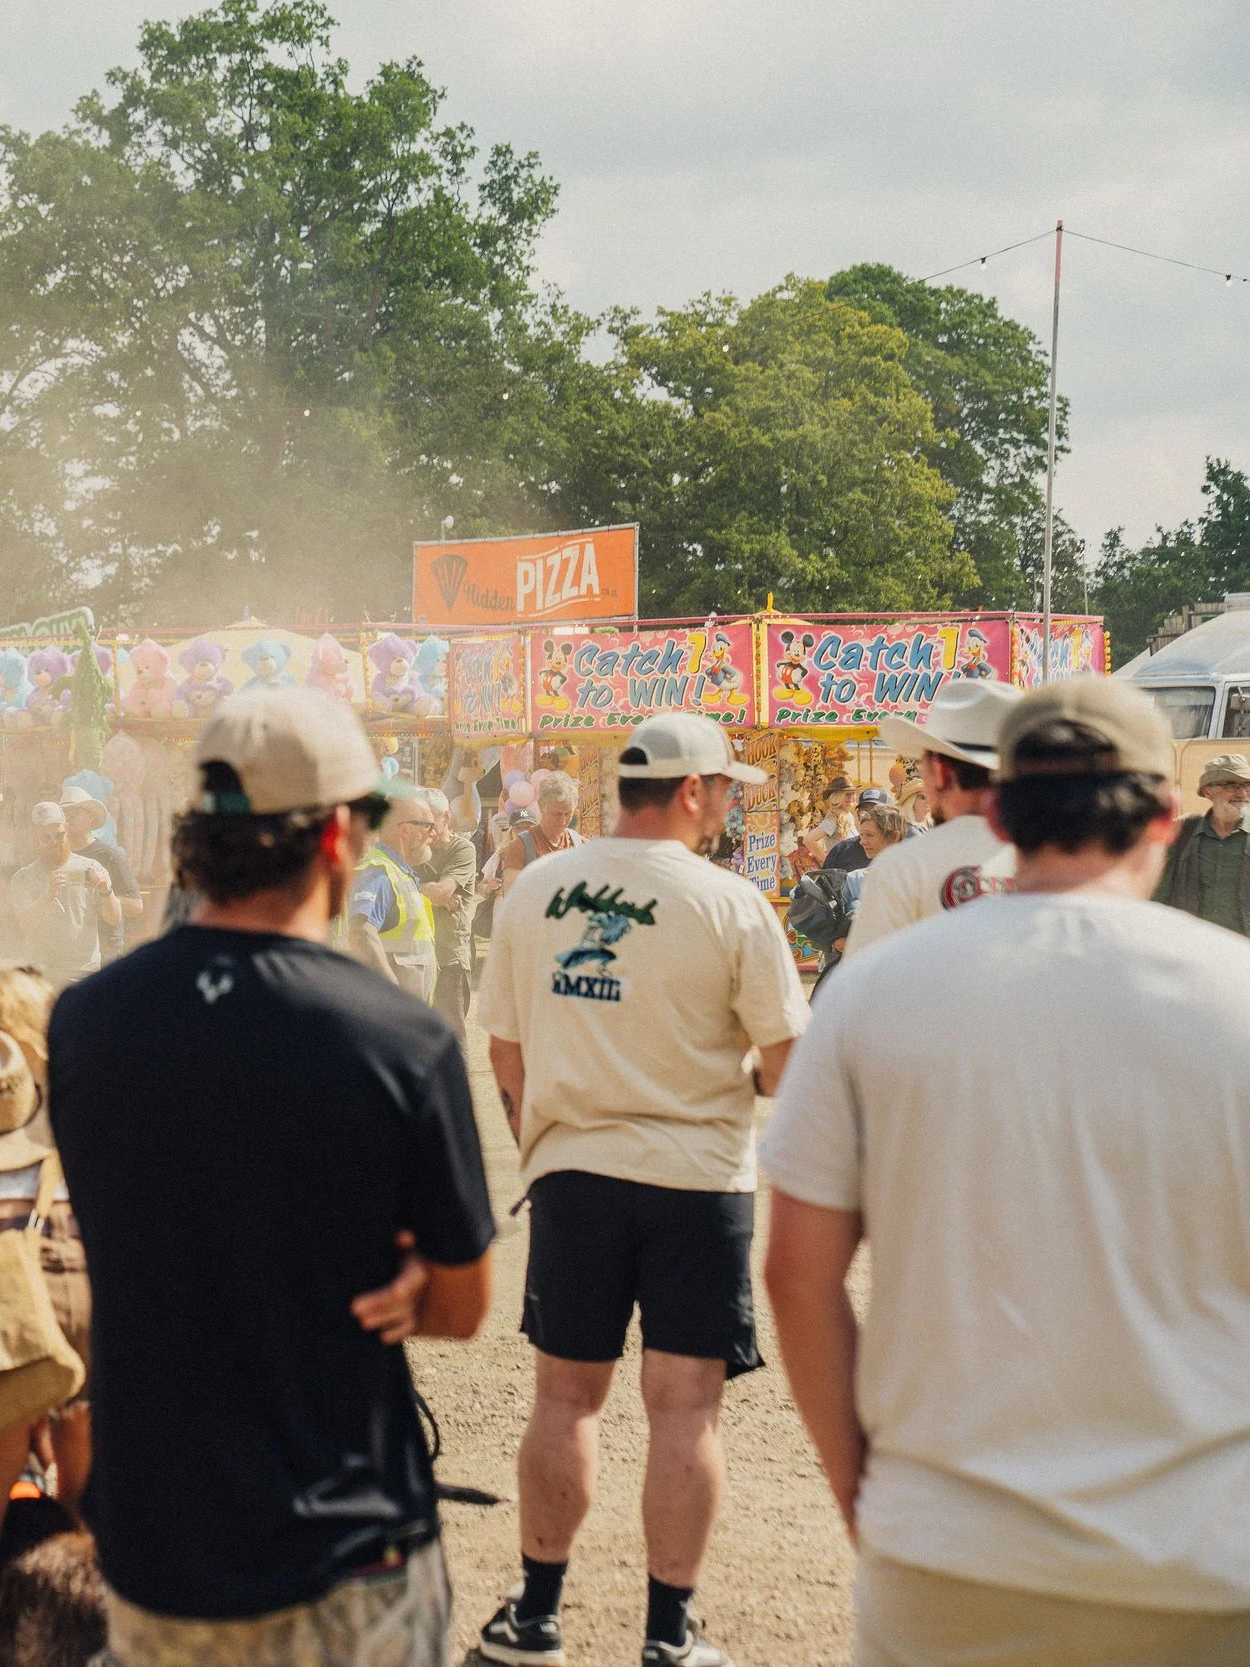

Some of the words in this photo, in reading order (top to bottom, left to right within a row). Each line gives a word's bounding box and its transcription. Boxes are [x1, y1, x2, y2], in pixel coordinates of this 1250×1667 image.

[517, 543, 600, 612] PIZZA
[573, 639, 684, 678] Catch
[686, 633, 707, 674] 1
[813, 633, 934, 671] Catch
[940, 627, 960, 670] 1
[576, 679, 614, 709] to
[821, 673, 857, 703] to
[539, 713, 596, 729] Prize
[775, 708, 839, 723] Prize
[748, 833, 775, 852] Prize
[746, 854, 777, 874] Every
